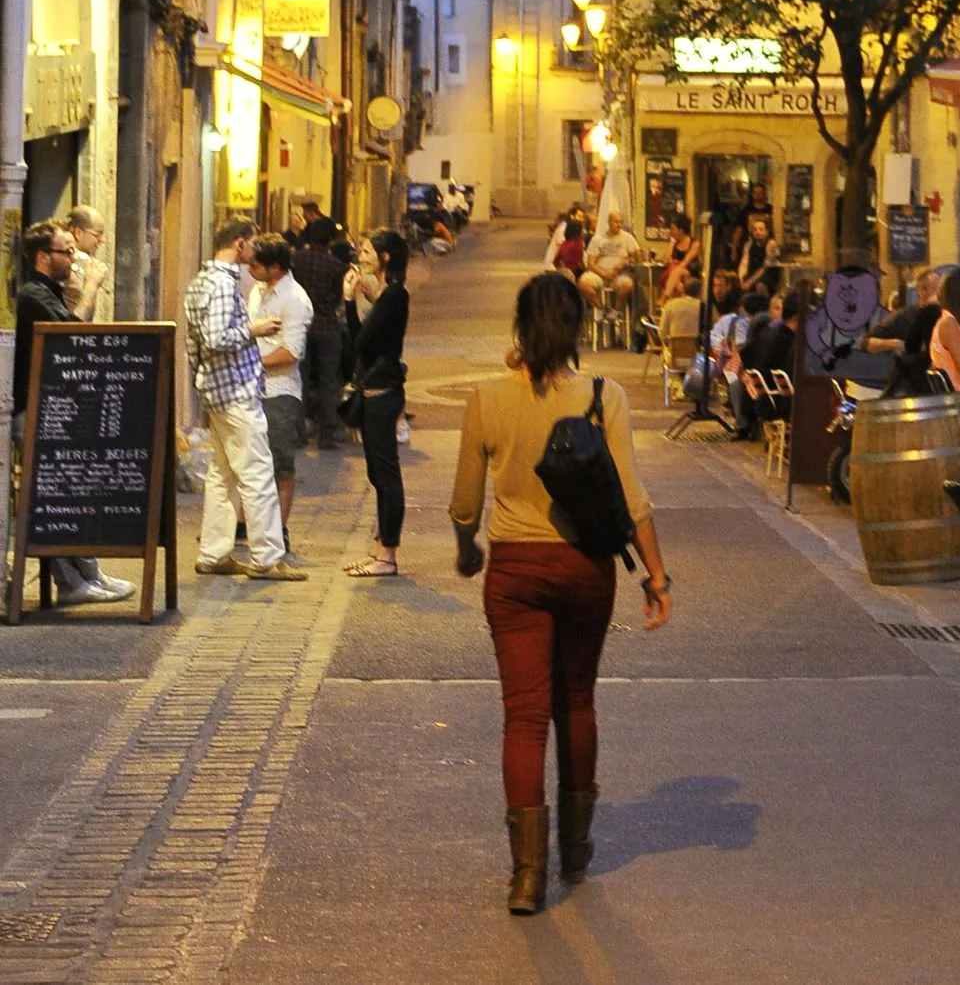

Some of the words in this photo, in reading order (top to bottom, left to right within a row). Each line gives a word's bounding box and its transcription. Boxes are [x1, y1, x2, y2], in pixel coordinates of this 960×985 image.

[676, 92, 699, 109] LE
[712, 92, 772, 110] SAINT
[70, 335, 97, 347] THE
[105, 371, 145, 382] HOURS
